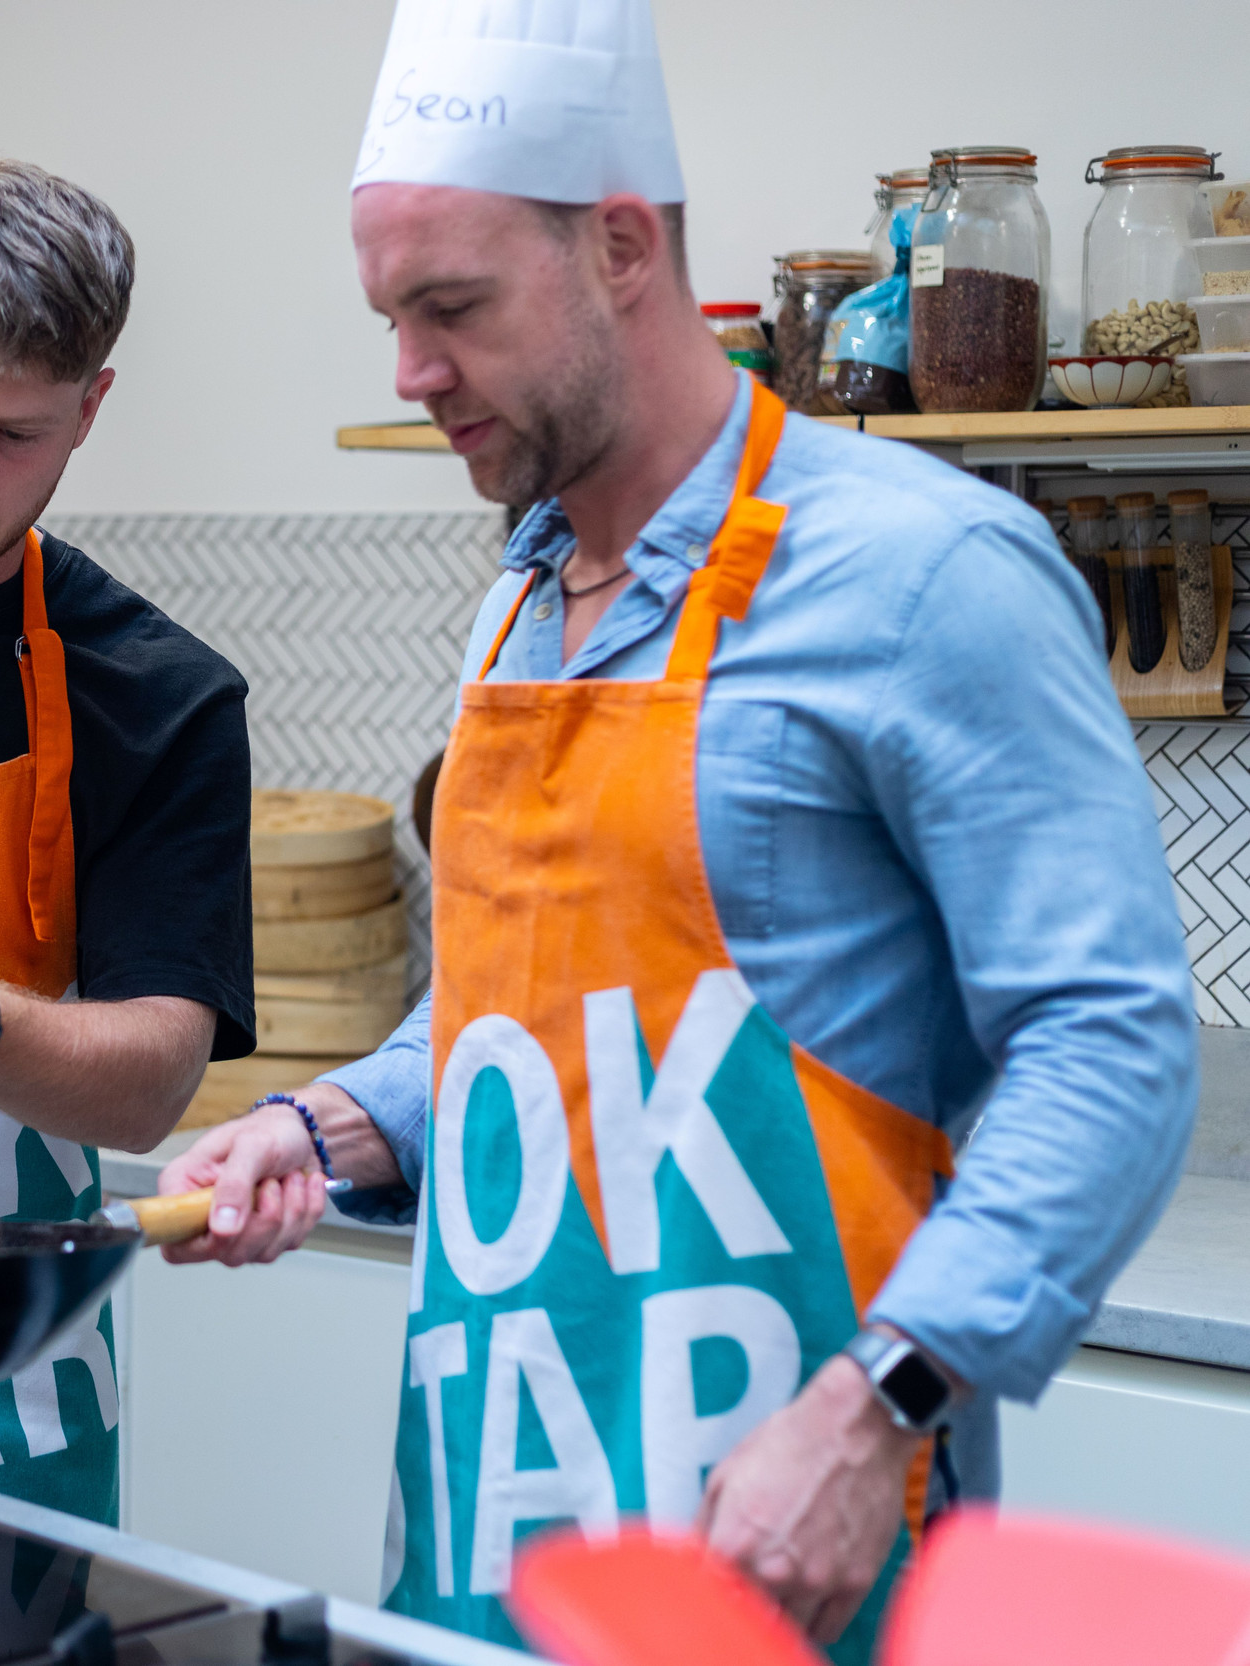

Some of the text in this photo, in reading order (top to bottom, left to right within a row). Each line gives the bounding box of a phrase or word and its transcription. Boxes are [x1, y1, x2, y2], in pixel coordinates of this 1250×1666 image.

[383, 68, 507, 127] Sean
[410, 967, 794, 1315] OK
[380, 1284, 802, 1612] TAR
